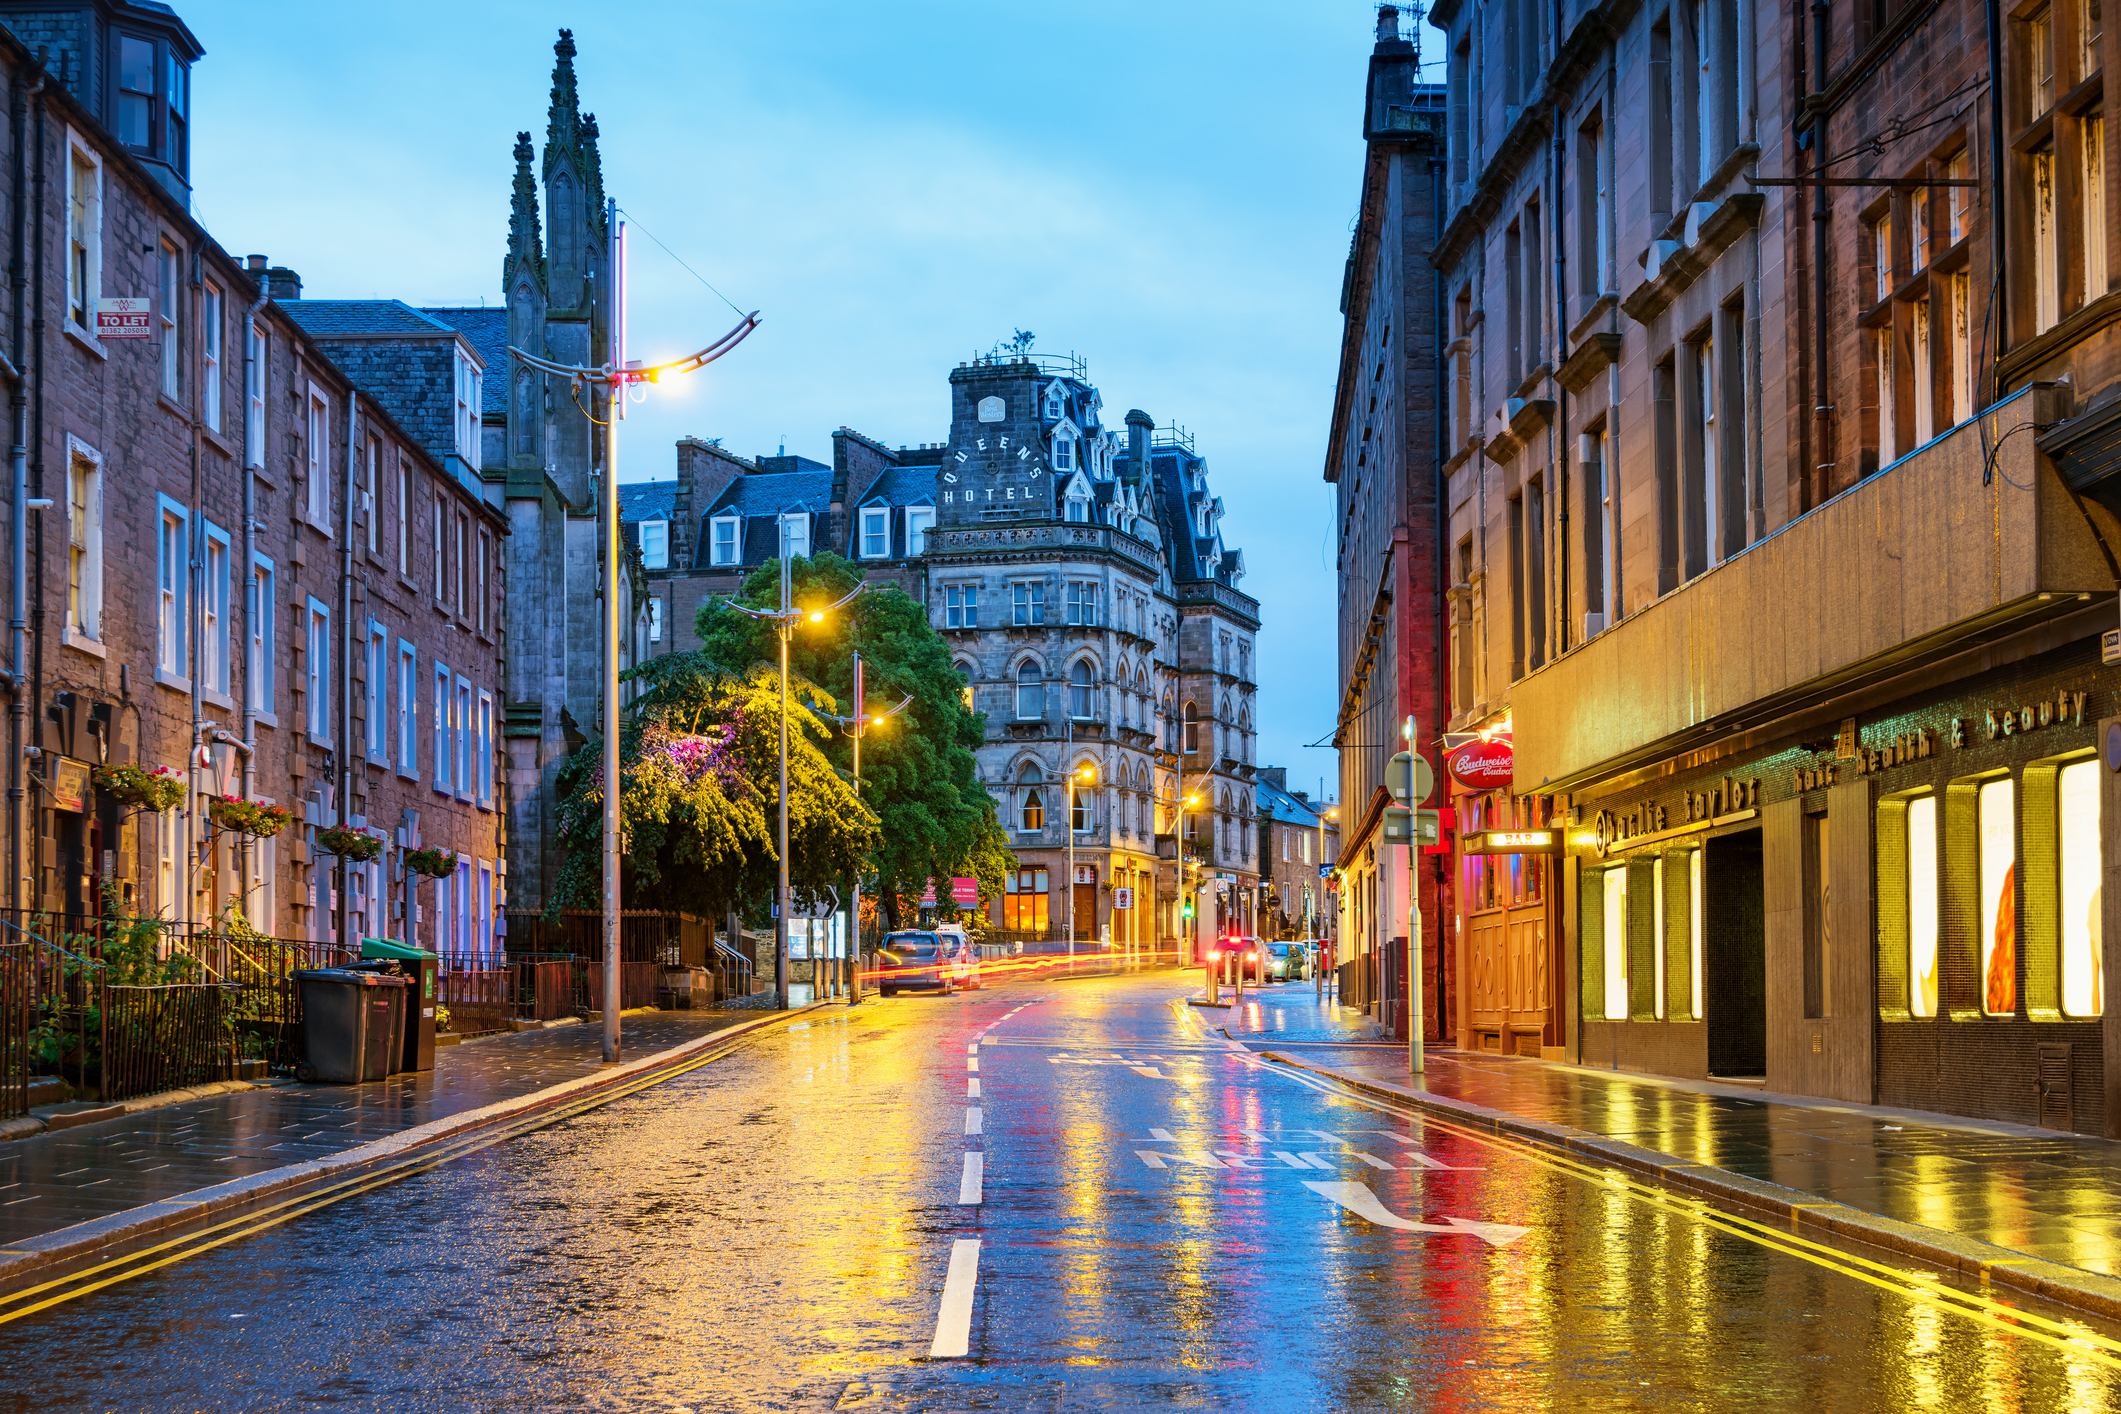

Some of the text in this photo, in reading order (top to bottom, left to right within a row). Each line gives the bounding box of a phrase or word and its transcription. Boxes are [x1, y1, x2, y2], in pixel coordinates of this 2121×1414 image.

[101, 316, 148, 326] TO LET
[943, 436, 1042, 484] QUEEN'S
[1793, 689, 2088, 793] hair health & beauty
[1684, 776, 1760, 827] taylor
[1505, 833, 1534, 845] BAR
[1134, 1150, 1487, 1171] TURN
